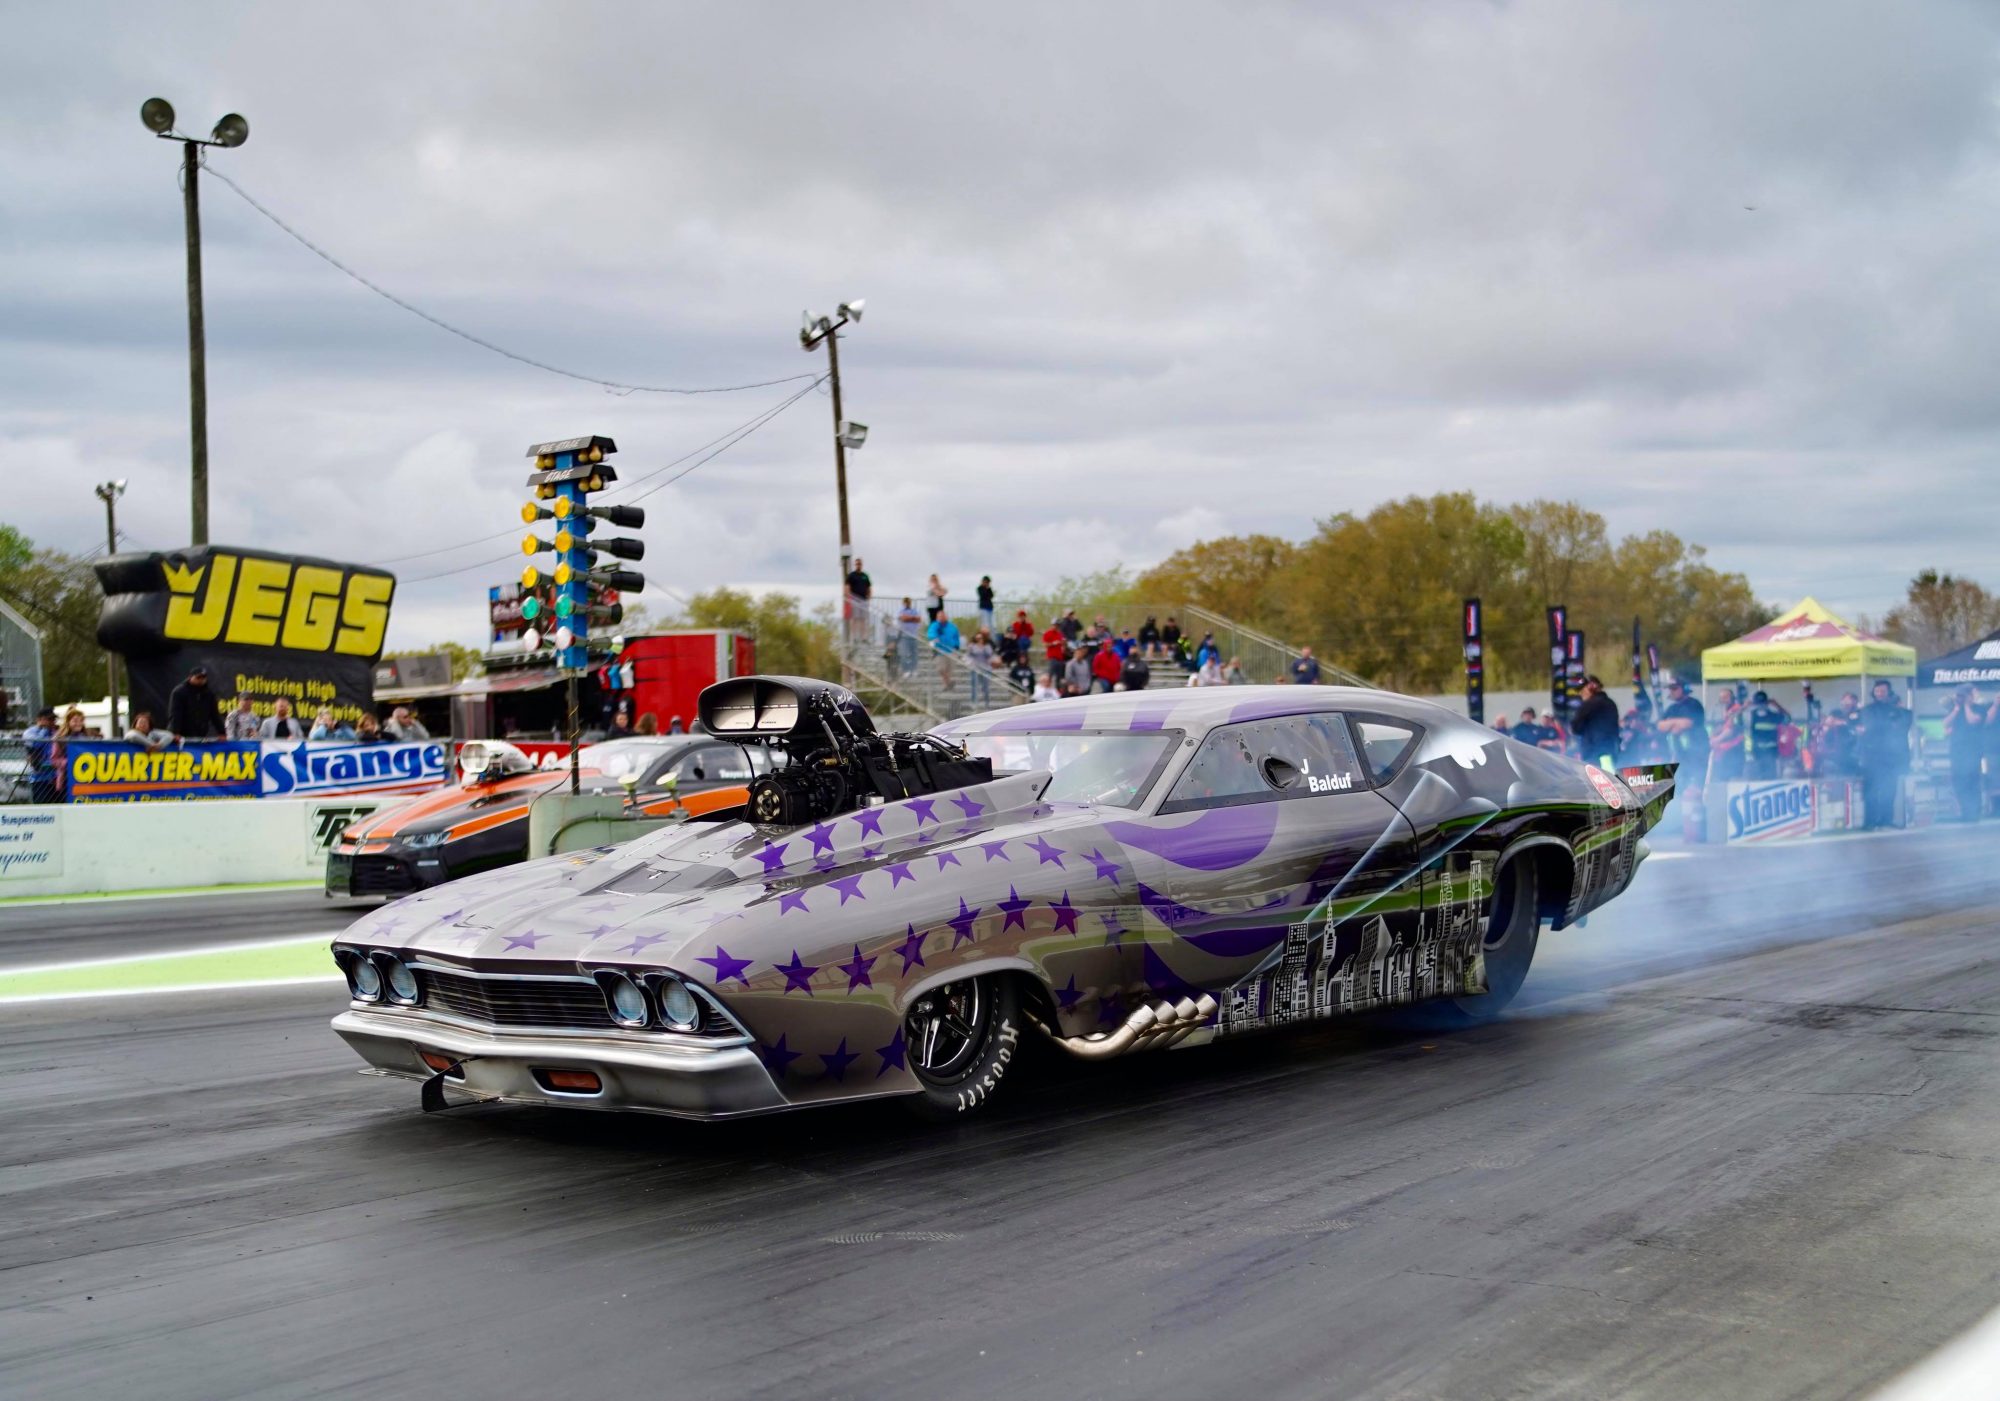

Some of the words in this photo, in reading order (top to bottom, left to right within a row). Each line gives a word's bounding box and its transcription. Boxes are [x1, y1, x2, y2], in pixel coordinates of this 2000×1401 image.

[164, 553, 394, 657] JEGS
[235, 673, 304, 699] Delivering
[306, 680, 336, 701] High
[72, 751, 259, 784] QUARTER-MAX
[262, 741, 445, 794] Strange
[1301, 758, 1309, 775] J
[1627, 774, 1655, 787] CHANCE
[1308, 771, 1352, 793] Balduf
[1, 813, 56, 828] Suspension
[1728, 784, 1811, 839] Strange
